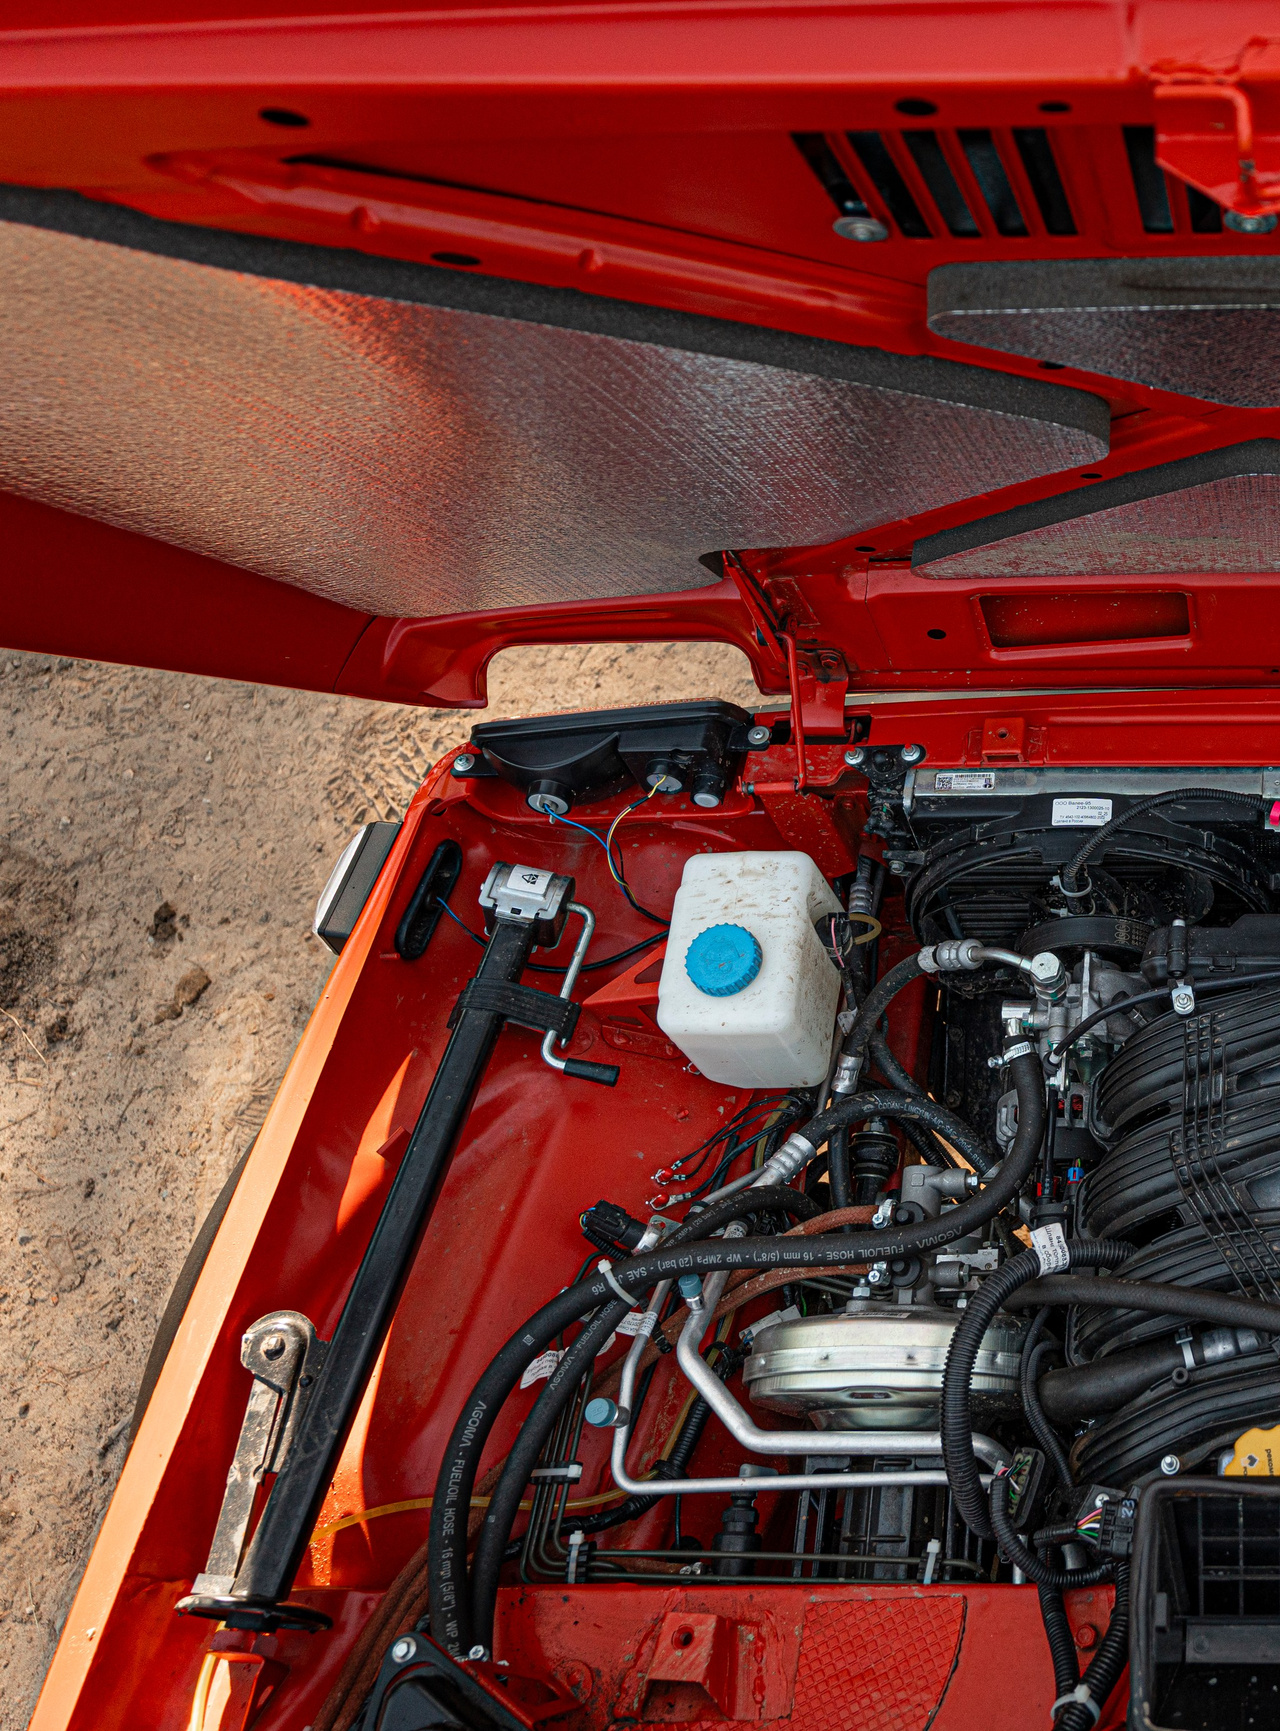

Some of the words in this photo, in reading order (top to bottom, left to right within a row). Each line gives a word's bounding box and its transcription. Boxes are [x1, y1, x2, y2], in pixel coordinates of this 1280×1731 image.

[916, 1225, 962, 1249] AGOMA
[726, 1253, 742, 1263] WP
[803, 1252, 814, 1261] 16
[826, 1251, 854, 1260] HOSE
[858, 1245, 904, 1258] FUEL/OIL
[679, 1254, 693, 1267] (20
[697, 1254, 722, 1264] 2MPa
[658, 1260, 677, 1273] bar)
[626, 1268, 648, 1281] SAE
[591, 1282, 606, 1295] R6
[549, 1356, 575, 1390] AGOMA
[577, 1319, 602, 1349] FUEL/OIL
[600, 1299, 618, 1318] HOSE
[459, 1400, 487, 1447] AGOMA
[445, 1459, 466, 1505] FUEL/OIL
[442, 1508, 456, 1536] HOSE
[442, 1547, 454, 1559] 16
[442, 1560, 452, 1579] mm
[439, 1581, 456, 1611] (5/8")
[446, 1620, 458, 1638] WP
